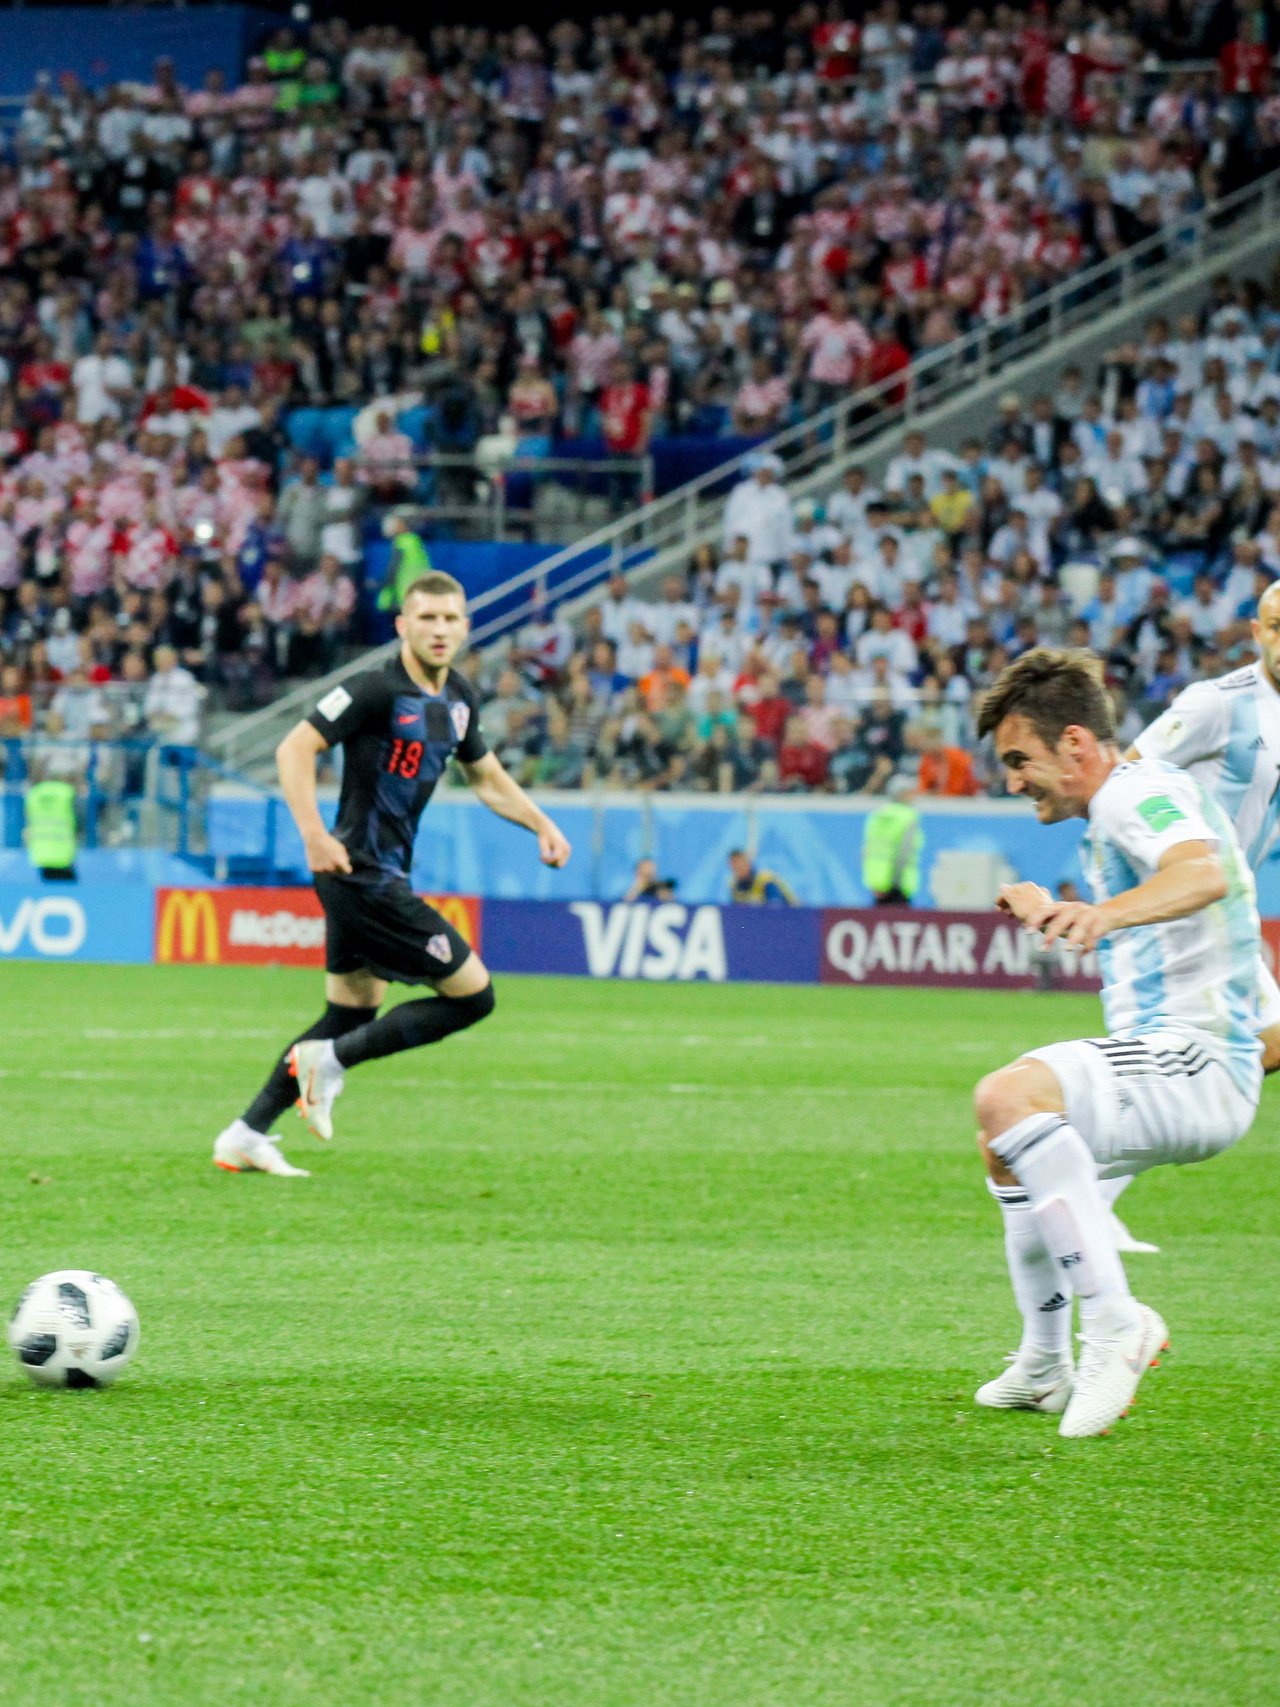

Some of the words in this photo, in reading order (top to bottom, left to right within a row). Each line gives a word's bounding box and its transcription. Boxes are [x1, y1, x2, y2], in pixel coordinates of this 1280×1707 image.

[388, 739, 424, 779] 18
[570, 901, 727, 981] VISA
[826, 919, 977, 981] QATAR
